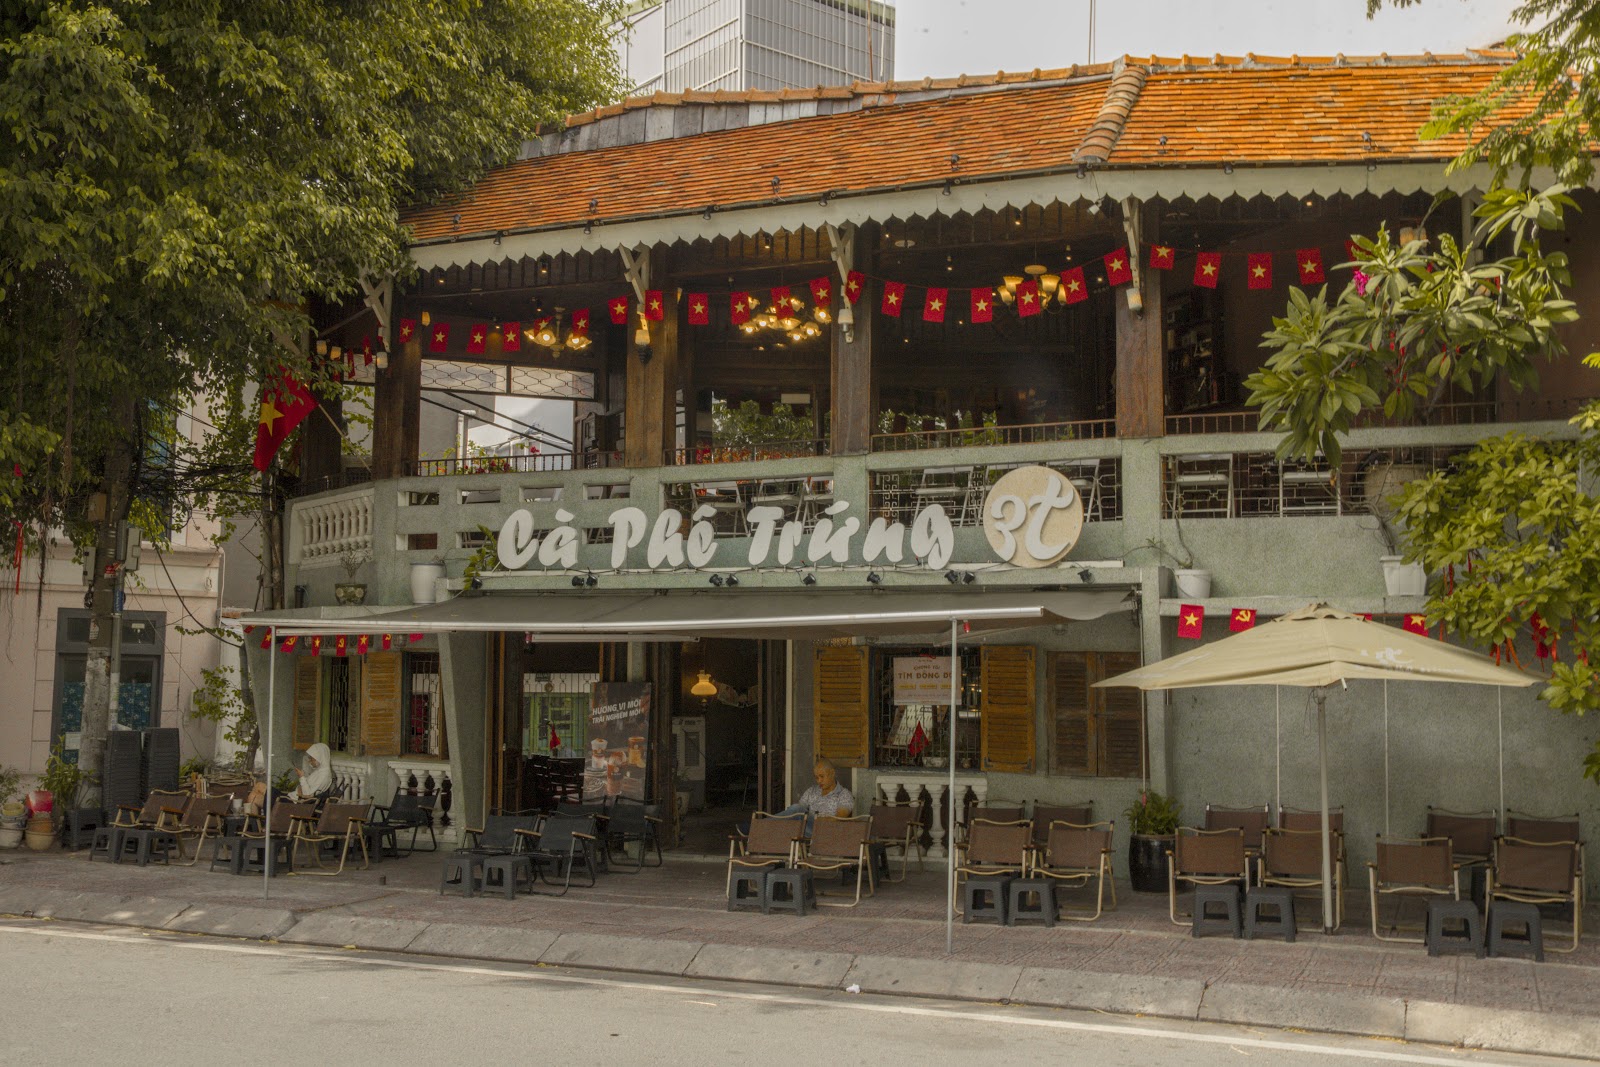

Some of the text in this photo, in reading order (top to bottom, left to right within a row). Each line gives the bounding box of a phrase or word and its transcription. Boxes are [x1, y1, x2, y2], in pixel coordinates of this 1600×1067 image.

[497, 500, 955, 570] Cà Phê Trứng
